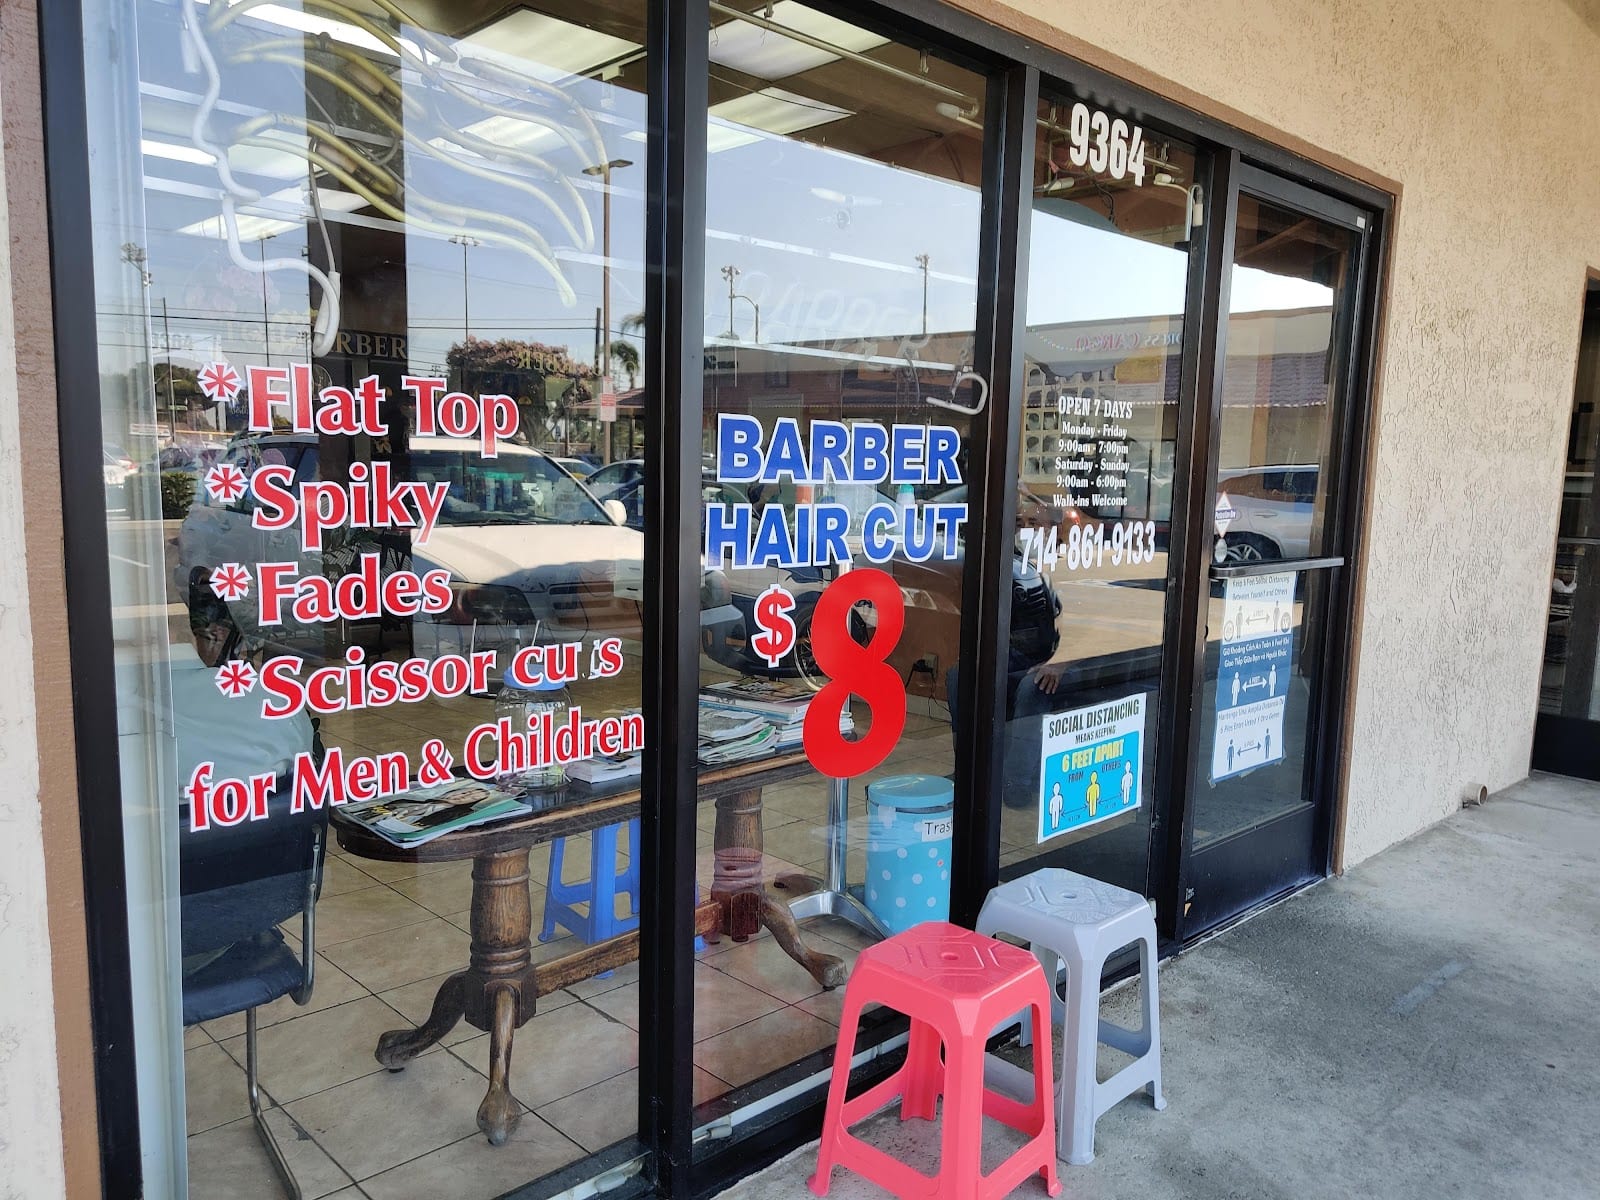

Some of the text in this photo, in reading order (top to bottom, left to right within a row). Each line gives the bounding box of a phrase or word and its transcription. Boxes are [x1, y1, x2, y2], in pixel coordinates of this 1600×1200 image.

[1069, 102, 1146, 187] 9364
[402, 374, 520, 459] Top
[1058, 396, 1133, 419] OPEN 7 DAYS
[1058, 440, 1091, 454] 9:00am
[1098, 441, 1129, 455] 7:00pm
[1062, 421, 1096, 438] Monday
[1102, 423, 1128, 440] Friday
[716, 412, 963, 485] BARBER
[1055, 457, 1093, 472] Saturday
[1100, 458, 1130, 472] Sunday
[1056, 475, 1089, 488] 9:00am
[1096, 474, 1127, 488] 6:00pm
[1053, 493, 1128, 507] Walk-ins Welcome
[704, 502, 969, 571] HAIR CUT
[1020, 520, 1156, 575] 714-861-9133
[511, 636, 624, 686] cus
[1049, 699, 1140, 739] SOCIAL DISTANCING
[1075, 725, 1117, 744] MEANS KEEPING
[185, 706, 645, 833] for Men & Children
[1062, 739, 1125, 773] 6 FEET APART
[924, 816, 953, 835] Tras
